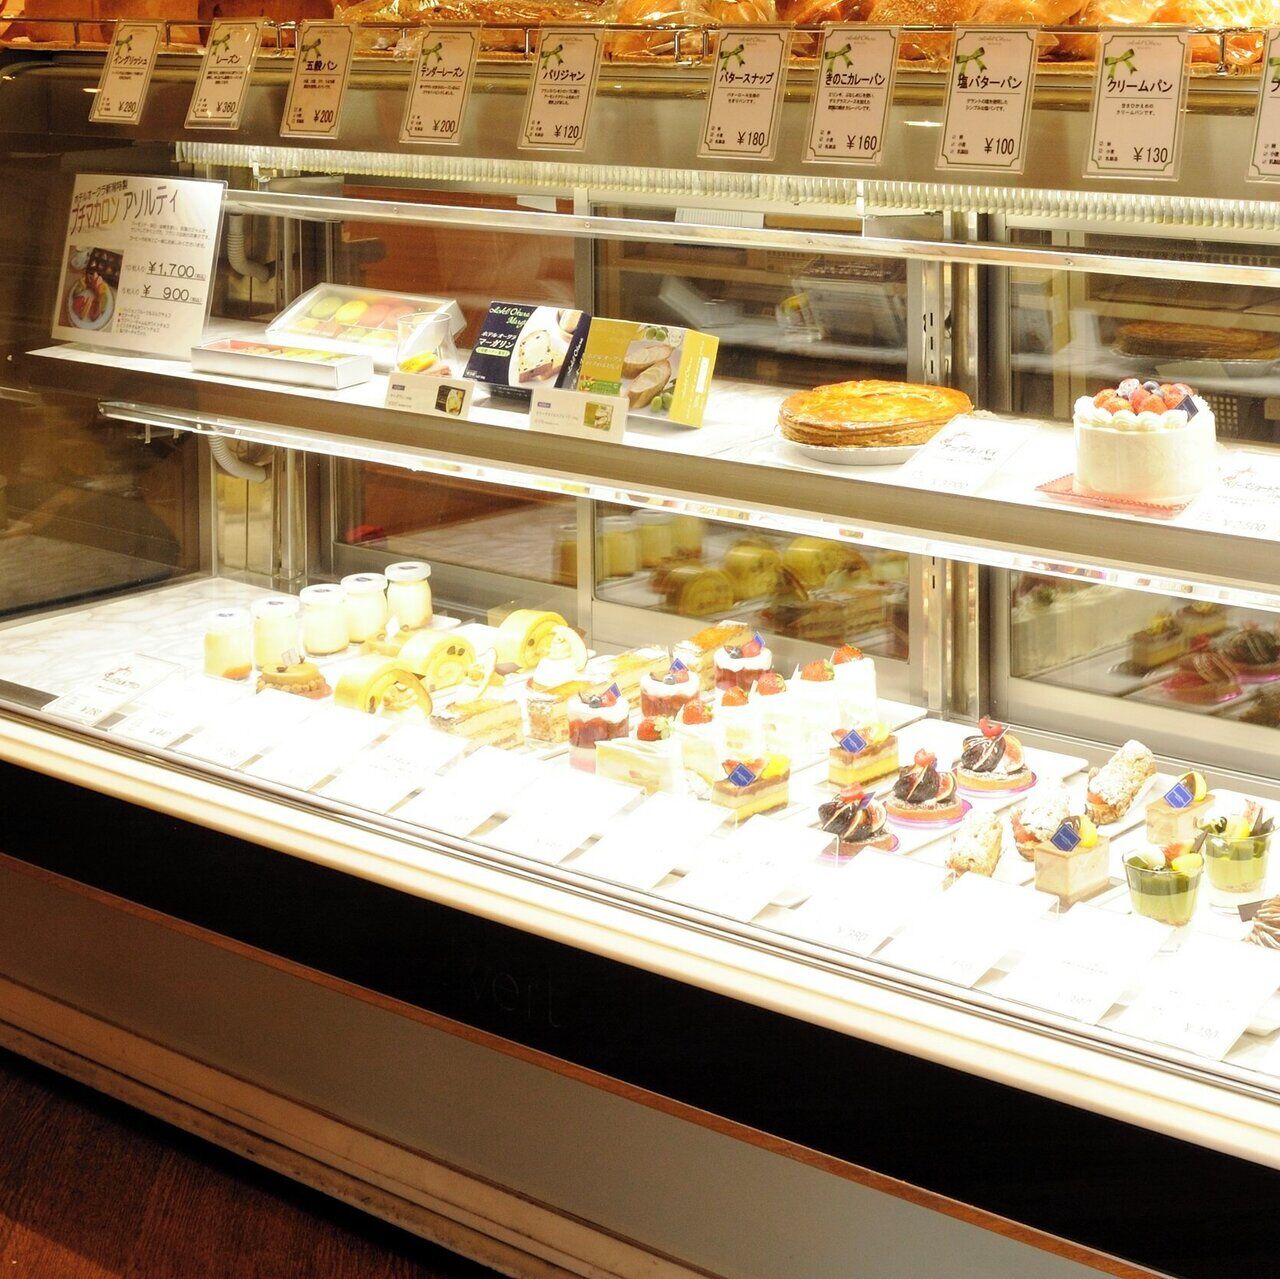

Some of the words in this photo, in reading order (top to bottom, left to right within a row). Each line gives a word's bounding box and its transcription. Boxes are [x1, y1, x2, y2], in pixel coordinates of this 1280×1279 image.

[113, 55, 147, 65] イングリッシュ
[216, 55, 241, 64] レーズン
[421, 66, 464, 77] テンダーレーズン
[825, 72, 886, 86] きのこカレーパン
[957, 74, 1022, 88] 塩バターパン
[1107, 79, 1173, 93] クリームパン
[314, 109, 334, 124] ¥200
[433, 120, 456, 133] ¥200
[554, 125, 579, 138] ¥120
[737, 131, 765, 146] ¥180
[847, 135, 878, 150] ¥160
[984, 137, 1014, 155] ¥100
[1133, 147, 1168, 163] ¥130
[123, 185, 179, 220] アソルティ
[149, 261, 195, 278] ¥1,700
[479, 338, 515, 349] マーガリン
